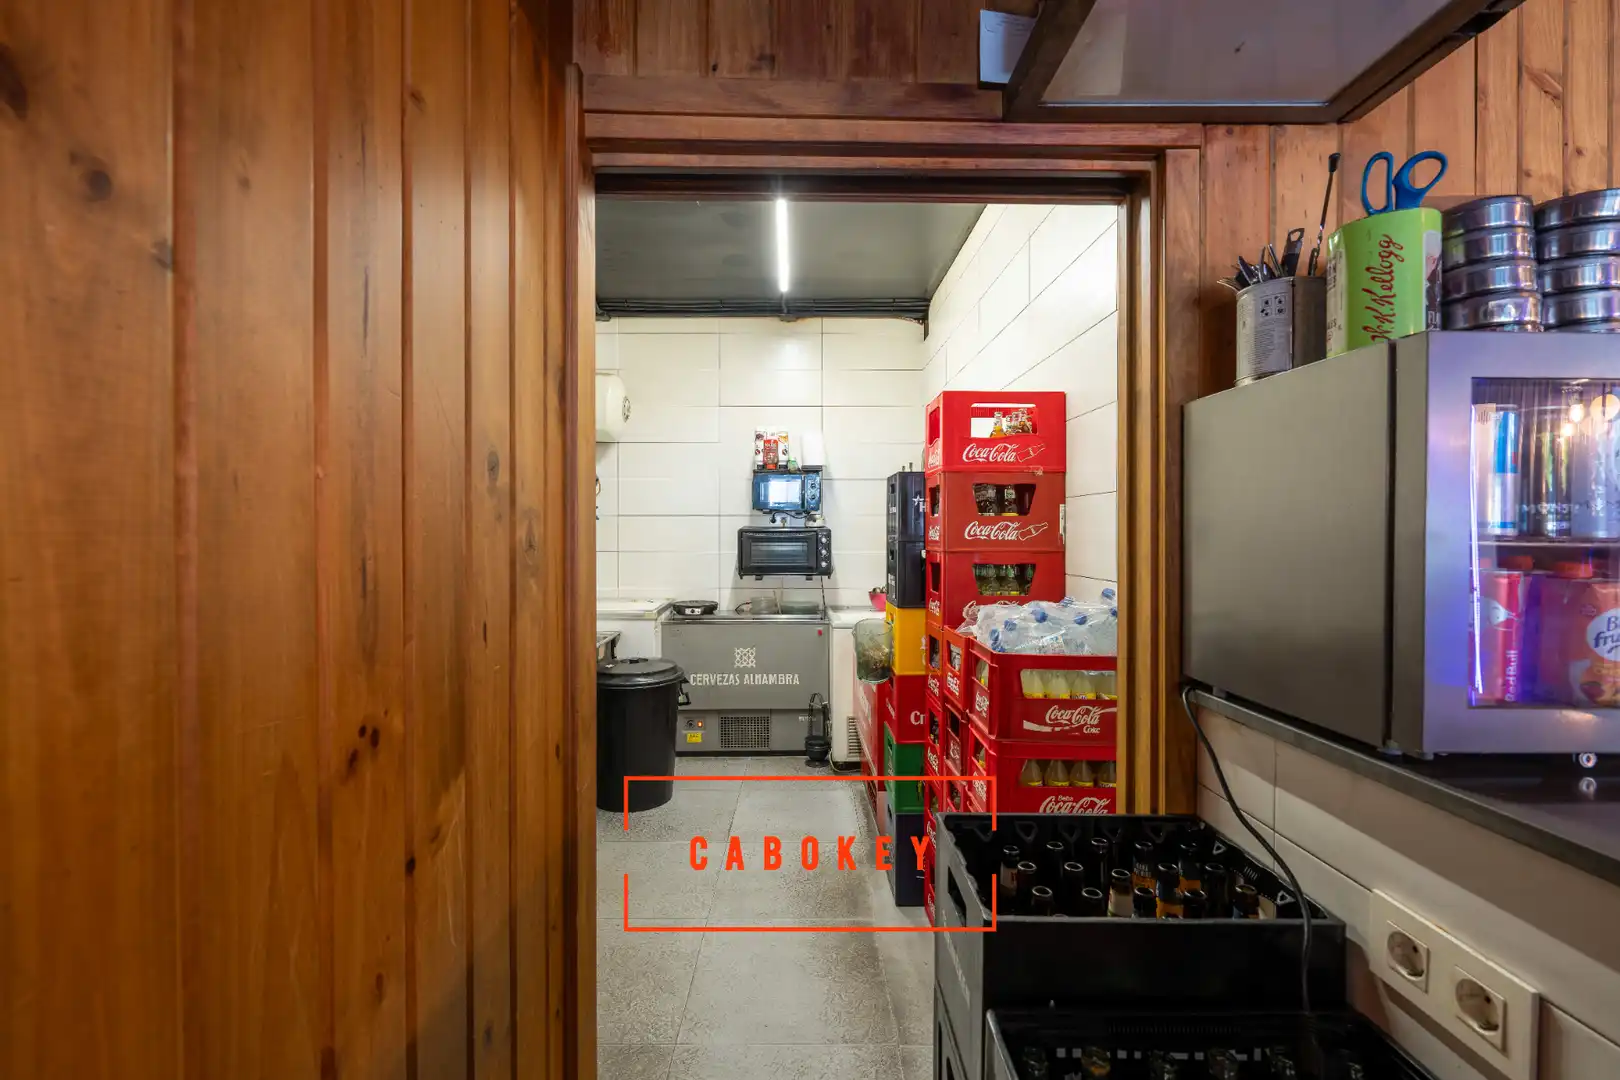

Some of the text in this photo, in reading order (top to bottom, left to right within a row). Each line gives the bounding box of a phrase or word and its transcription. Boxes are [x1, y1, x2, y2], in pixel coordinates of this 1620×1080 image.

[962, 443, 1020, 463] Coca-Cola
[964, 521, 1021, 540] Coca-Cola
[689, 673, 800, 686] CERVEZAS ALHAMBRA
[1045, 705, 1101, 725] Coca-Cola
[1039, 796, 1111, 815] Coca-Cola
